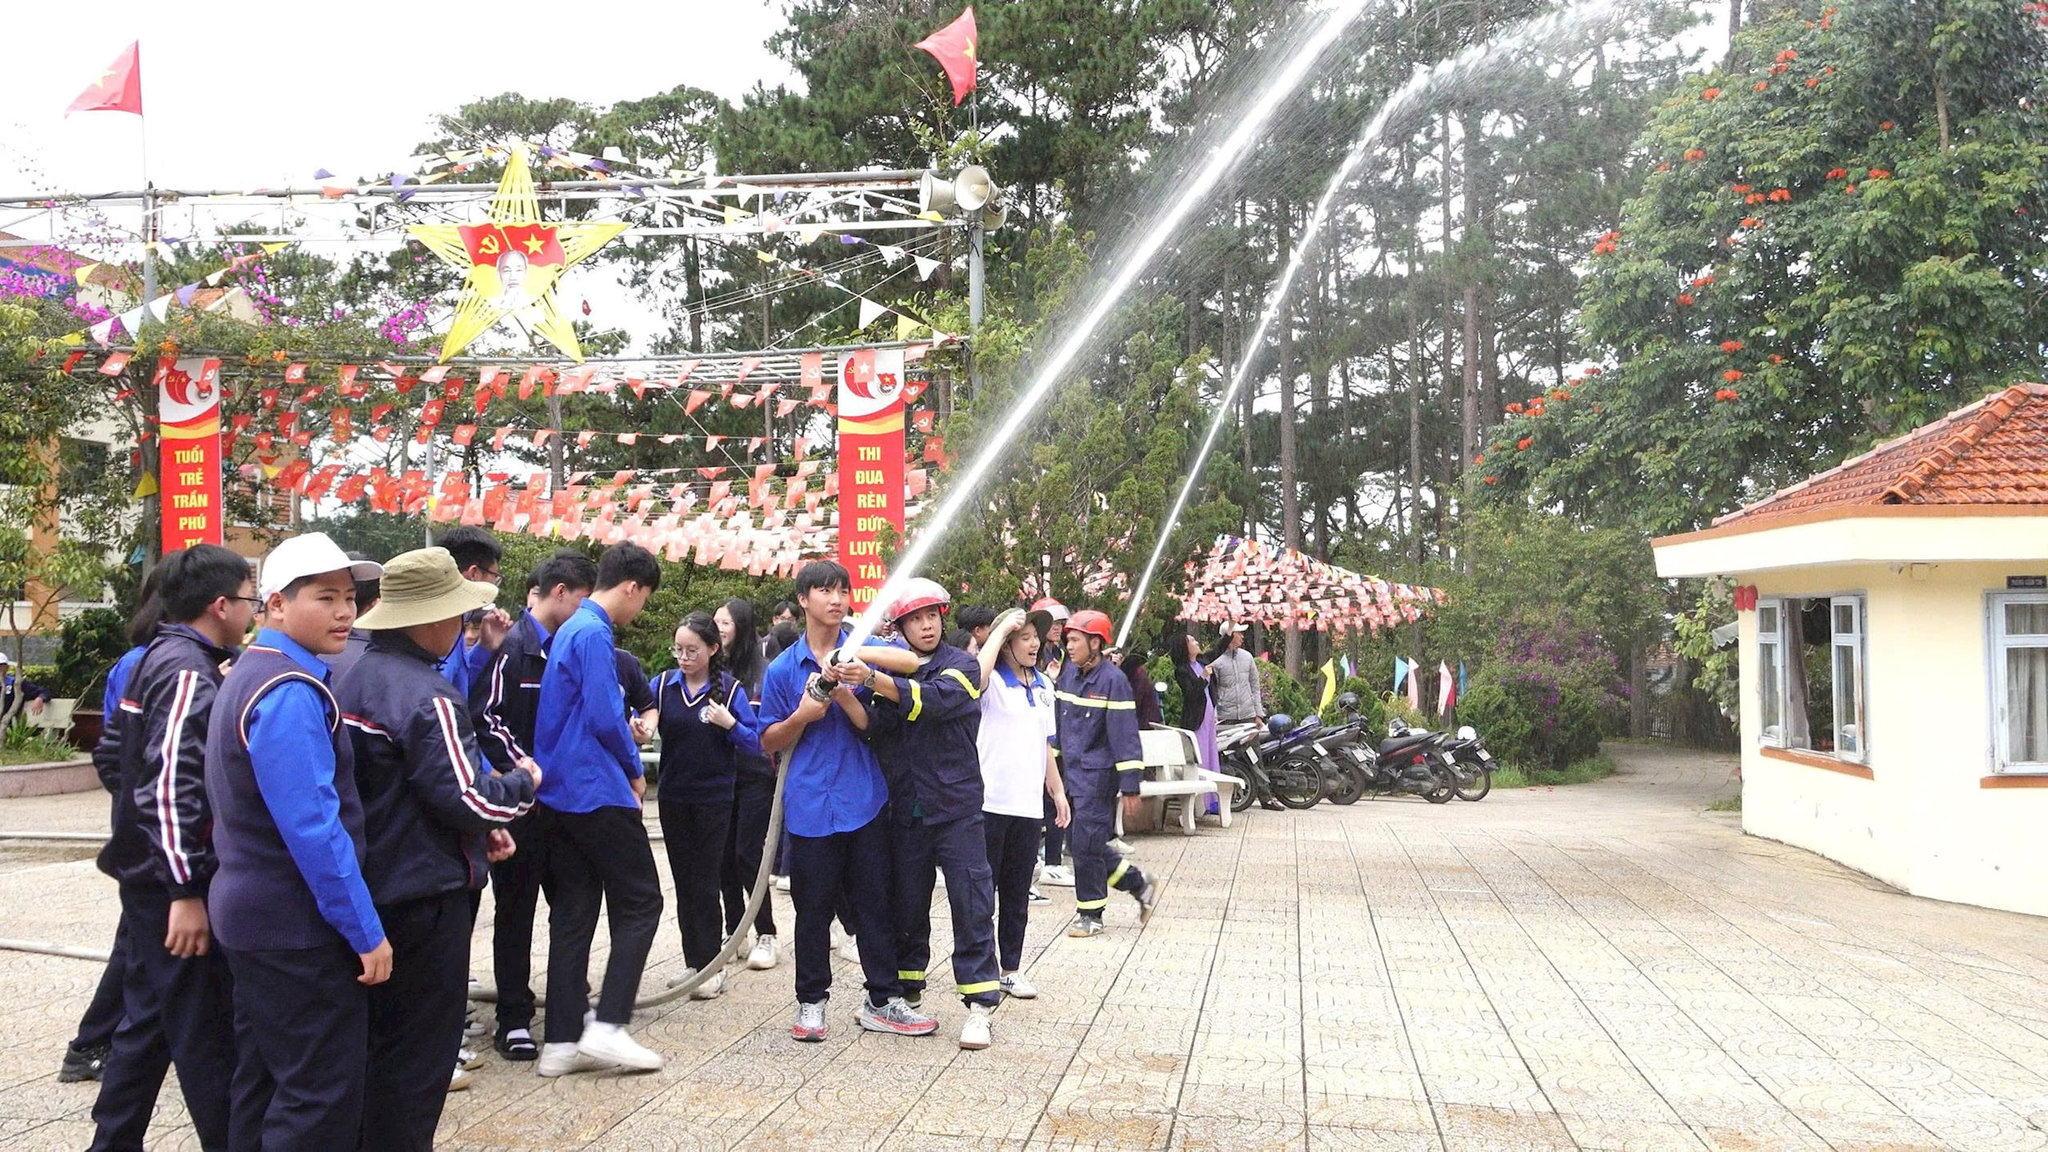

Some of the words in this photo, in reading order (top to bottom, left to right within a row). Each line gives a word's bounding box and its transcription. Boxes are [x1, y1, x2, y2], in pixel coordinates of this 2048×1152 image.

[858, 446, 881, 461] THI
[855, 470, 884, 485] ĐUA
[857, 490, 887, 508] RÈN
[179, 513, 206, 531] PHÚ
